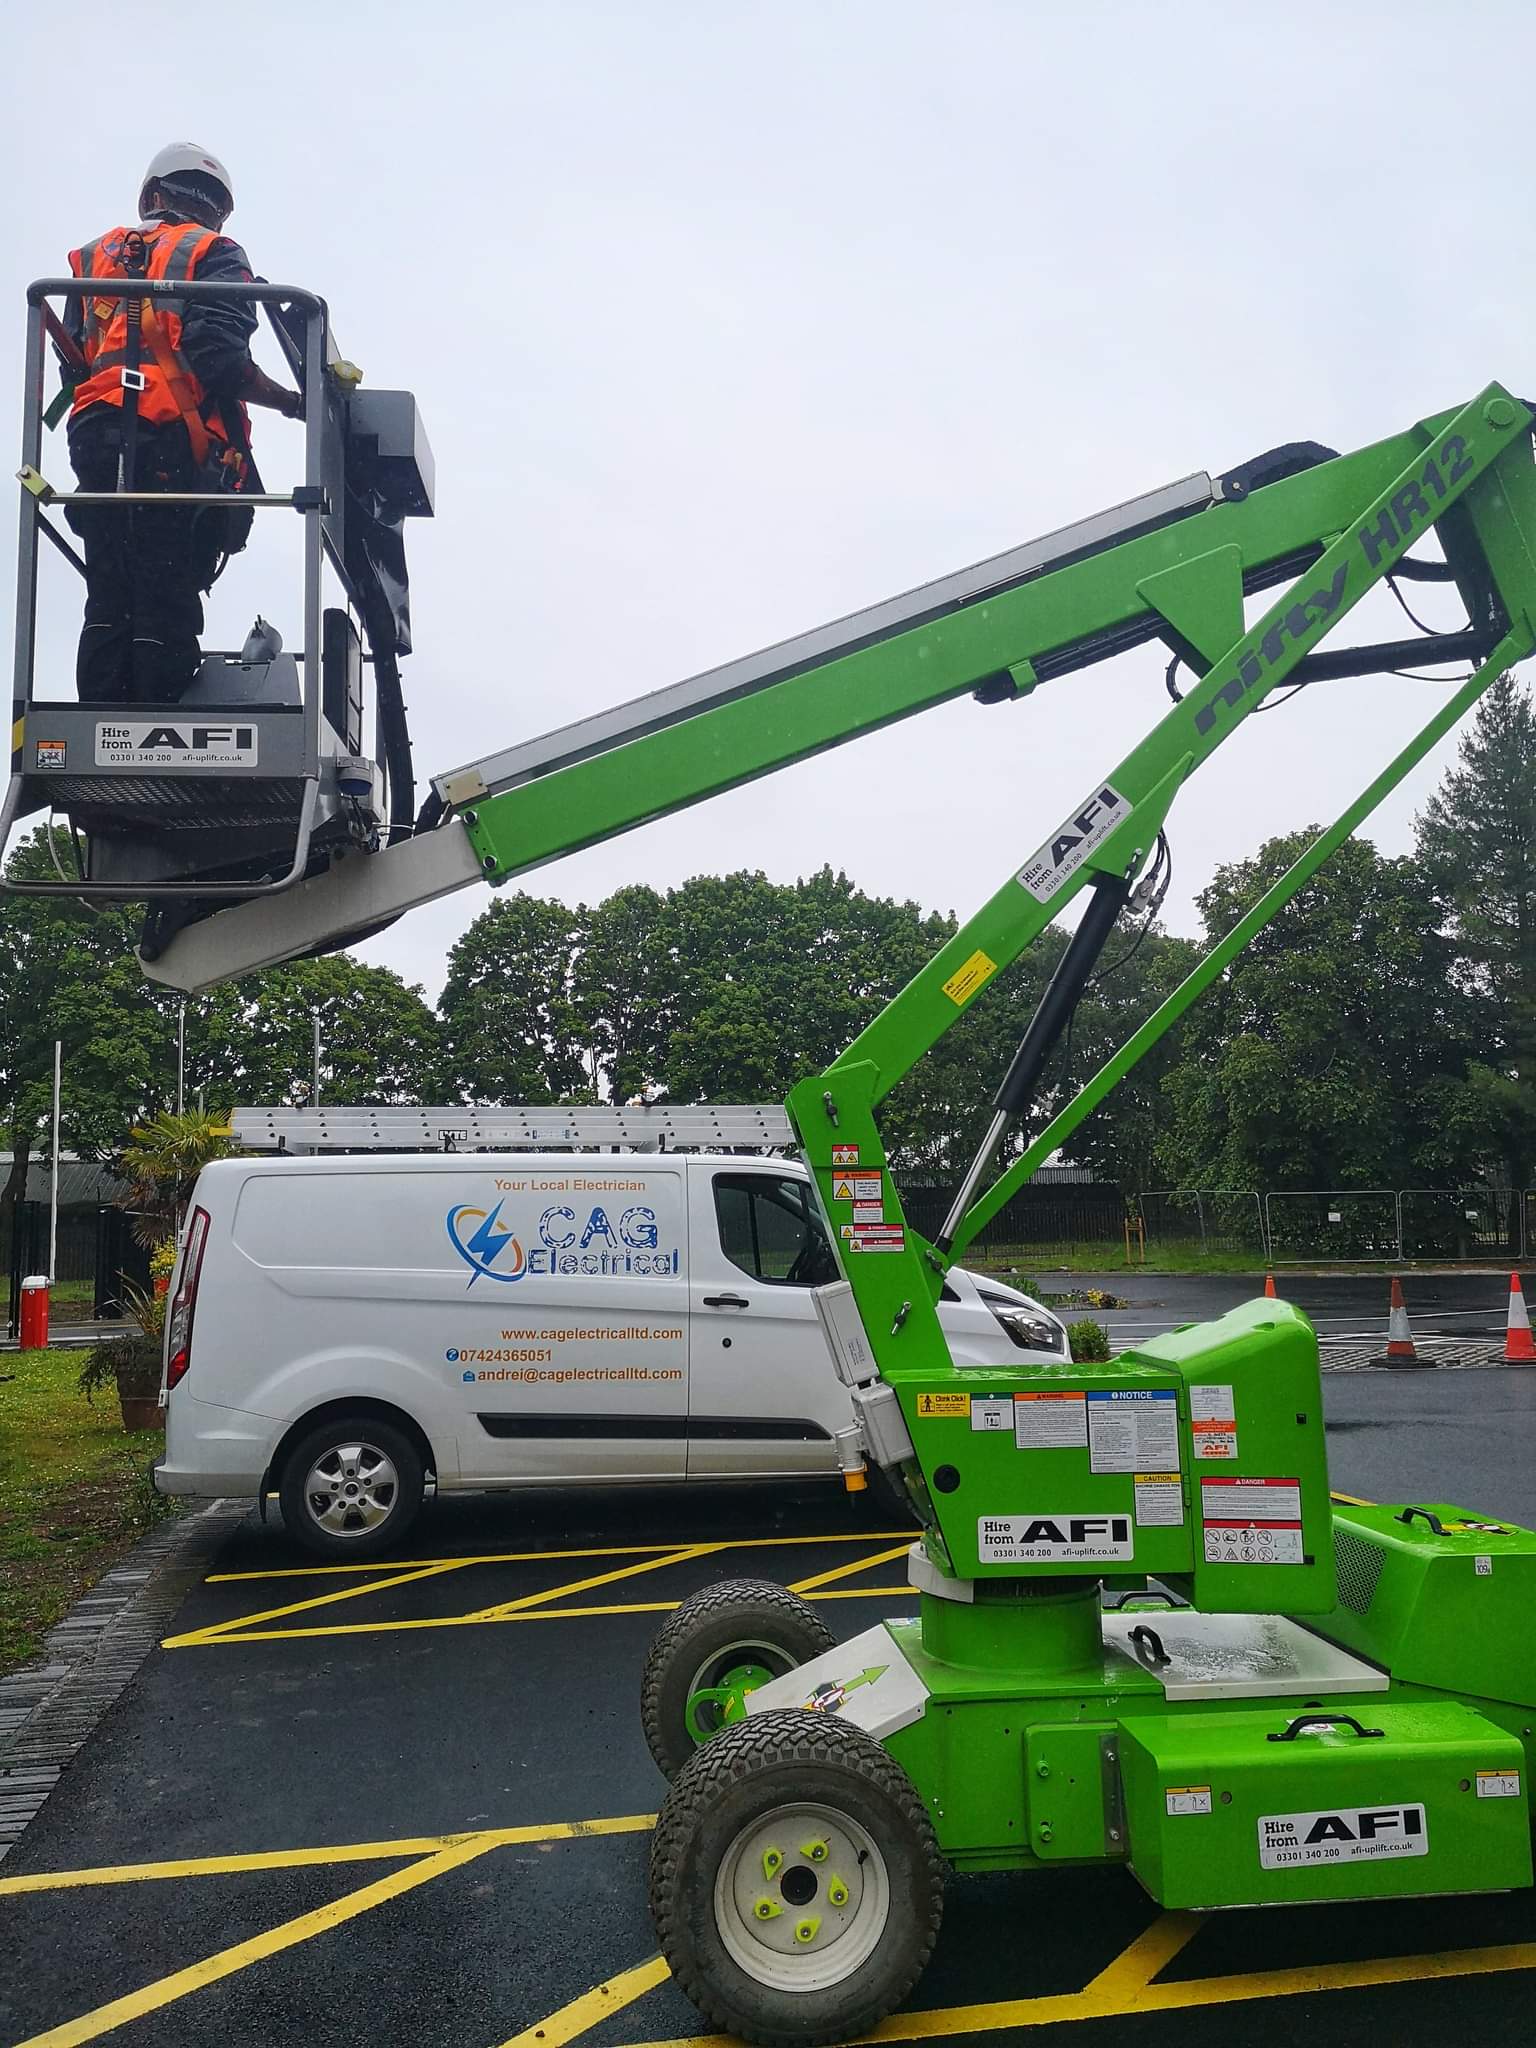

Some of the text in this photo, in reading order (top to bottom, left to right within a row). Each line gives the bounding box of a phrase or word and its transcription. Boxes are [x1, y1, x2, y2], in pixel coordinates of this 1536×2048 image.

[1194, 434, 1474, 736] nifty HR12
[102, 727, 130, 738] Hire
[137, 728, 252, 749] AFI
[101, 739, 132, 749] from
[182, 754, 243, 762] afi-uplift.co.uk
[1051, 788, 1120, 869] AFI
[1022, 863, 1043, 884] Hire
[1030, 867, 1053, 890] from
[494, 1179, 646, 1191] Your Local Electrician
[539, 1206, 658, 1249] CAG
[528, 1248, 679, 1275] Electrical
[501, 1327, 683, 1343] www.cagelectricalltd.com
[460, 1349, 552, 1362] 07424365051
[478, 1368, 682, 1383] andrei@cagelectricalltd.com
[1120, 1391, 1152, 1399] NOTICE
[984, 1521, 1011, 1532] Hire
[1019, 1519, 1128, 1543] AFI
[984, 1534, 1014, 1545] from
[1020, 1549, 1035, 1557] 340
[1062, 1547, 1119, 1557] afi-uplift.co.uk
[1264, 1821, 1294, 1834] Hire
[1304, 1809, 1422, 1844] AFI
[1266, 1836, 1299, 1848] from
[1351, 1842, 1413, 1856] afi-uplift.co.uk
[1277, 1848, 1340, 1862] 03301 340 200
